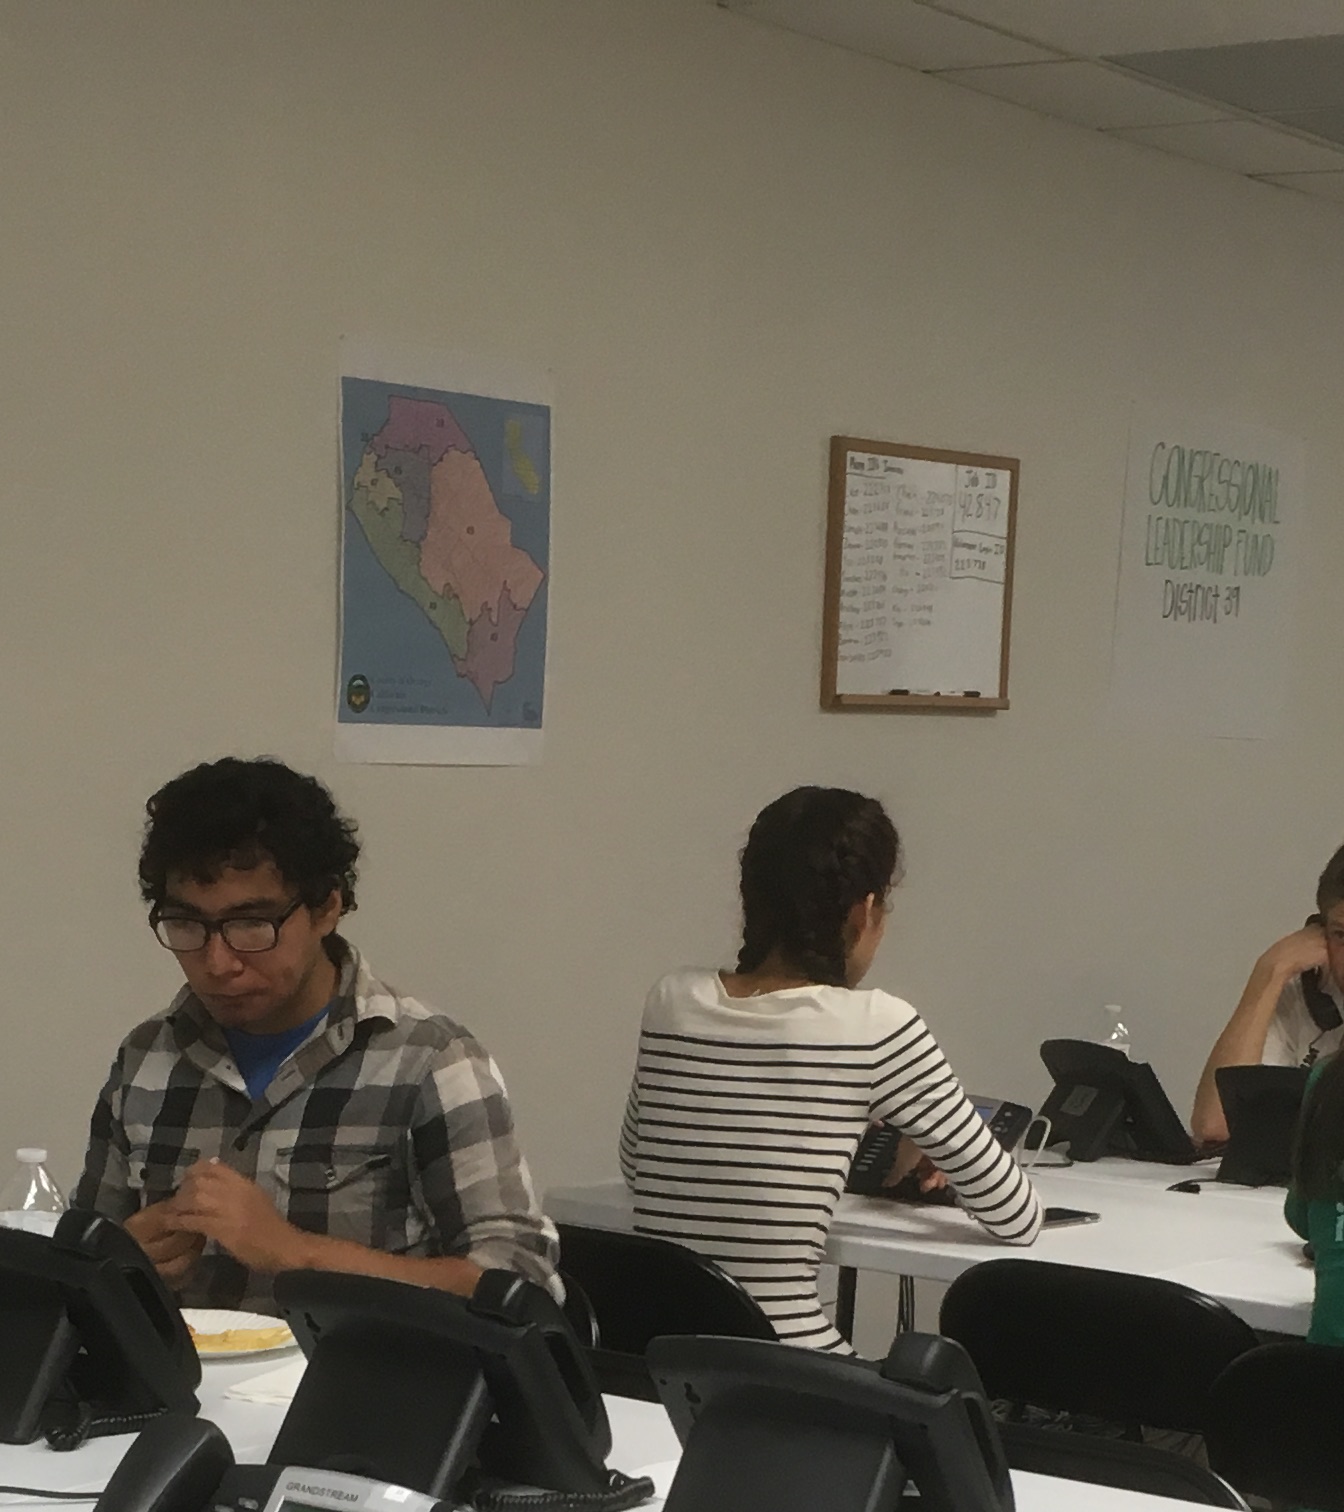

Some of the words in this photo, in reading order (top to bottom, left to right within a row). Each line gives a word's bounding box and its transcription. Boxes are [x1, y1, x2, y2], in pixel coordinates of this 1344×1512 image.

[1149, 441, 1281, 524] CONGRESSIONAL
[1145, 514, 1233, 575] LEADERSHIP
[1234, 529, 1276, 577] FUND
[1224, 585, 1241, 618] 39
[286, 1481, 359, 1503] GRANDSTREAM
